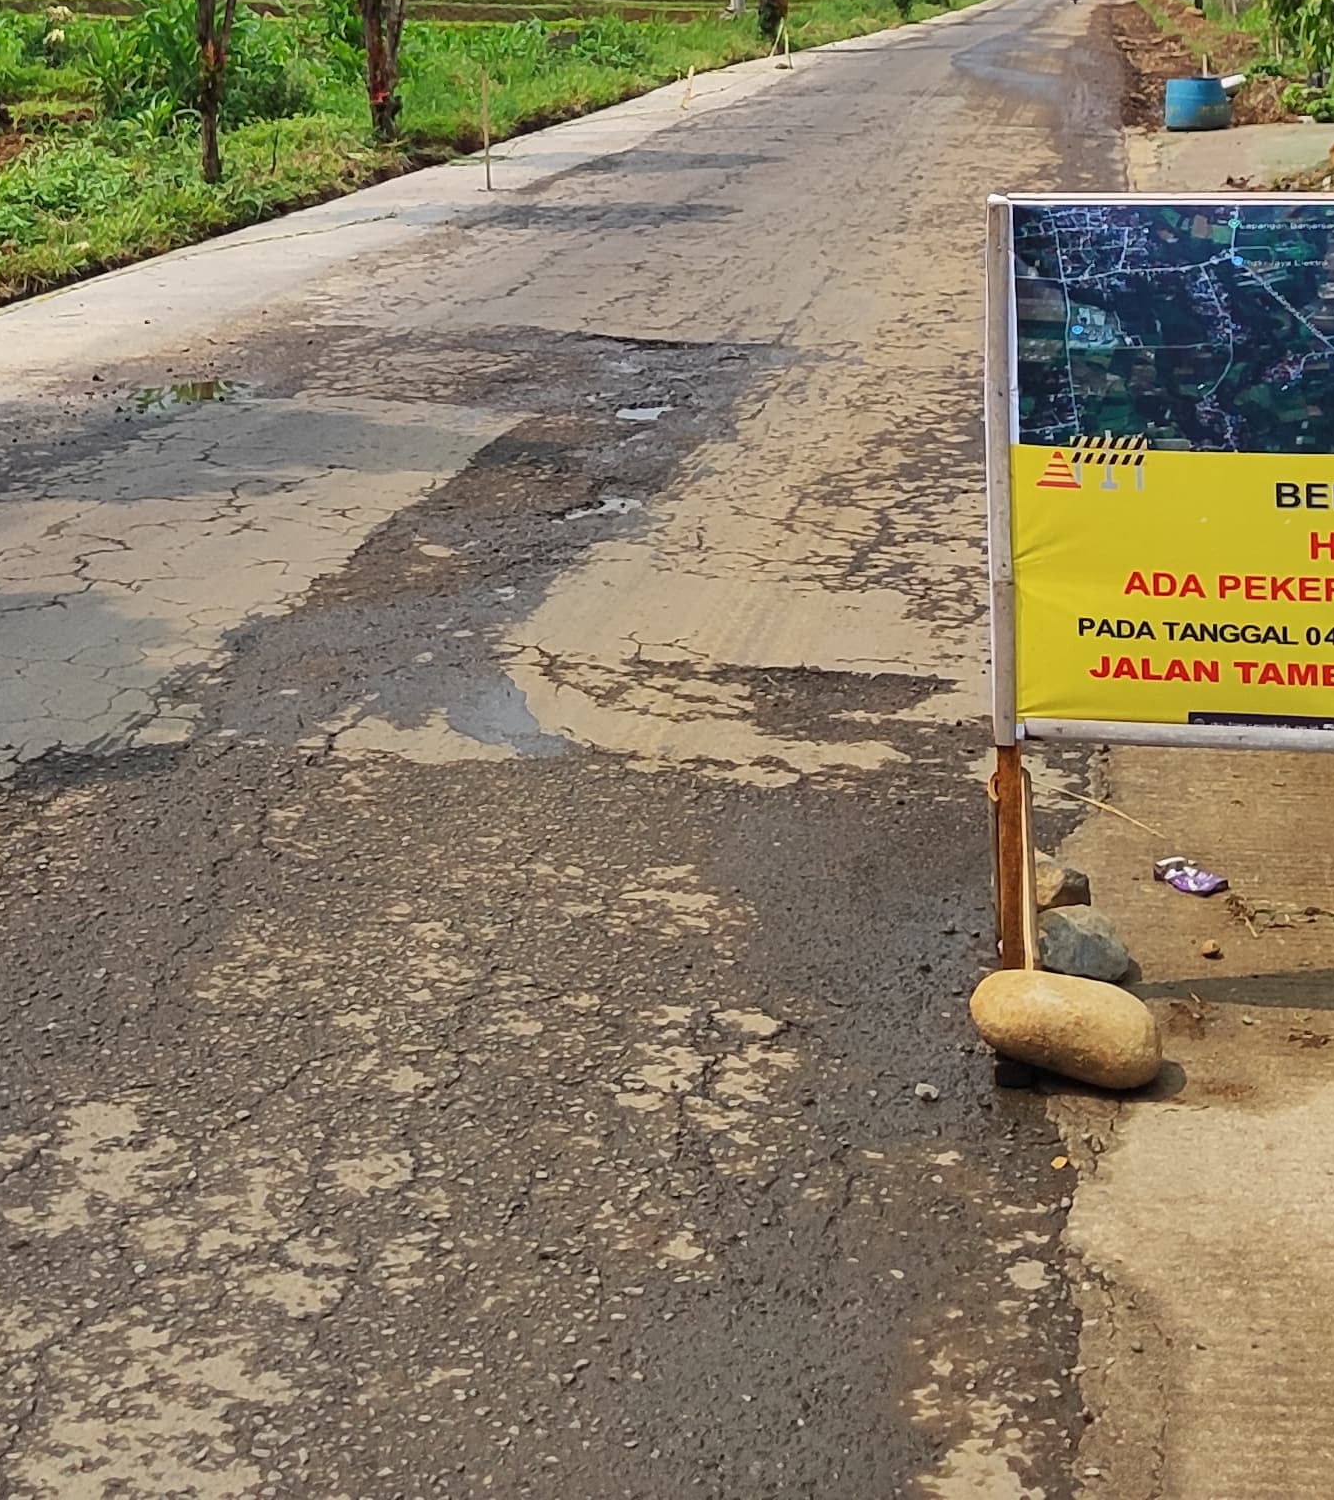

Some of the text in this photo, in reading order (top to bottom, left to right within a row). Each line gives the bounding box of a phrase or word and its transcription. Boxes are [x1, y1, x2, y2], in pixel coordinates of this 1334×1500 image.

[1123, 571, 1206, 599] ADA
[1077, 617, 1157, 641] PADA
[1162, 621, 1299, 645] TANGGAL
[1089, 656, 1220, 683] JALAN
